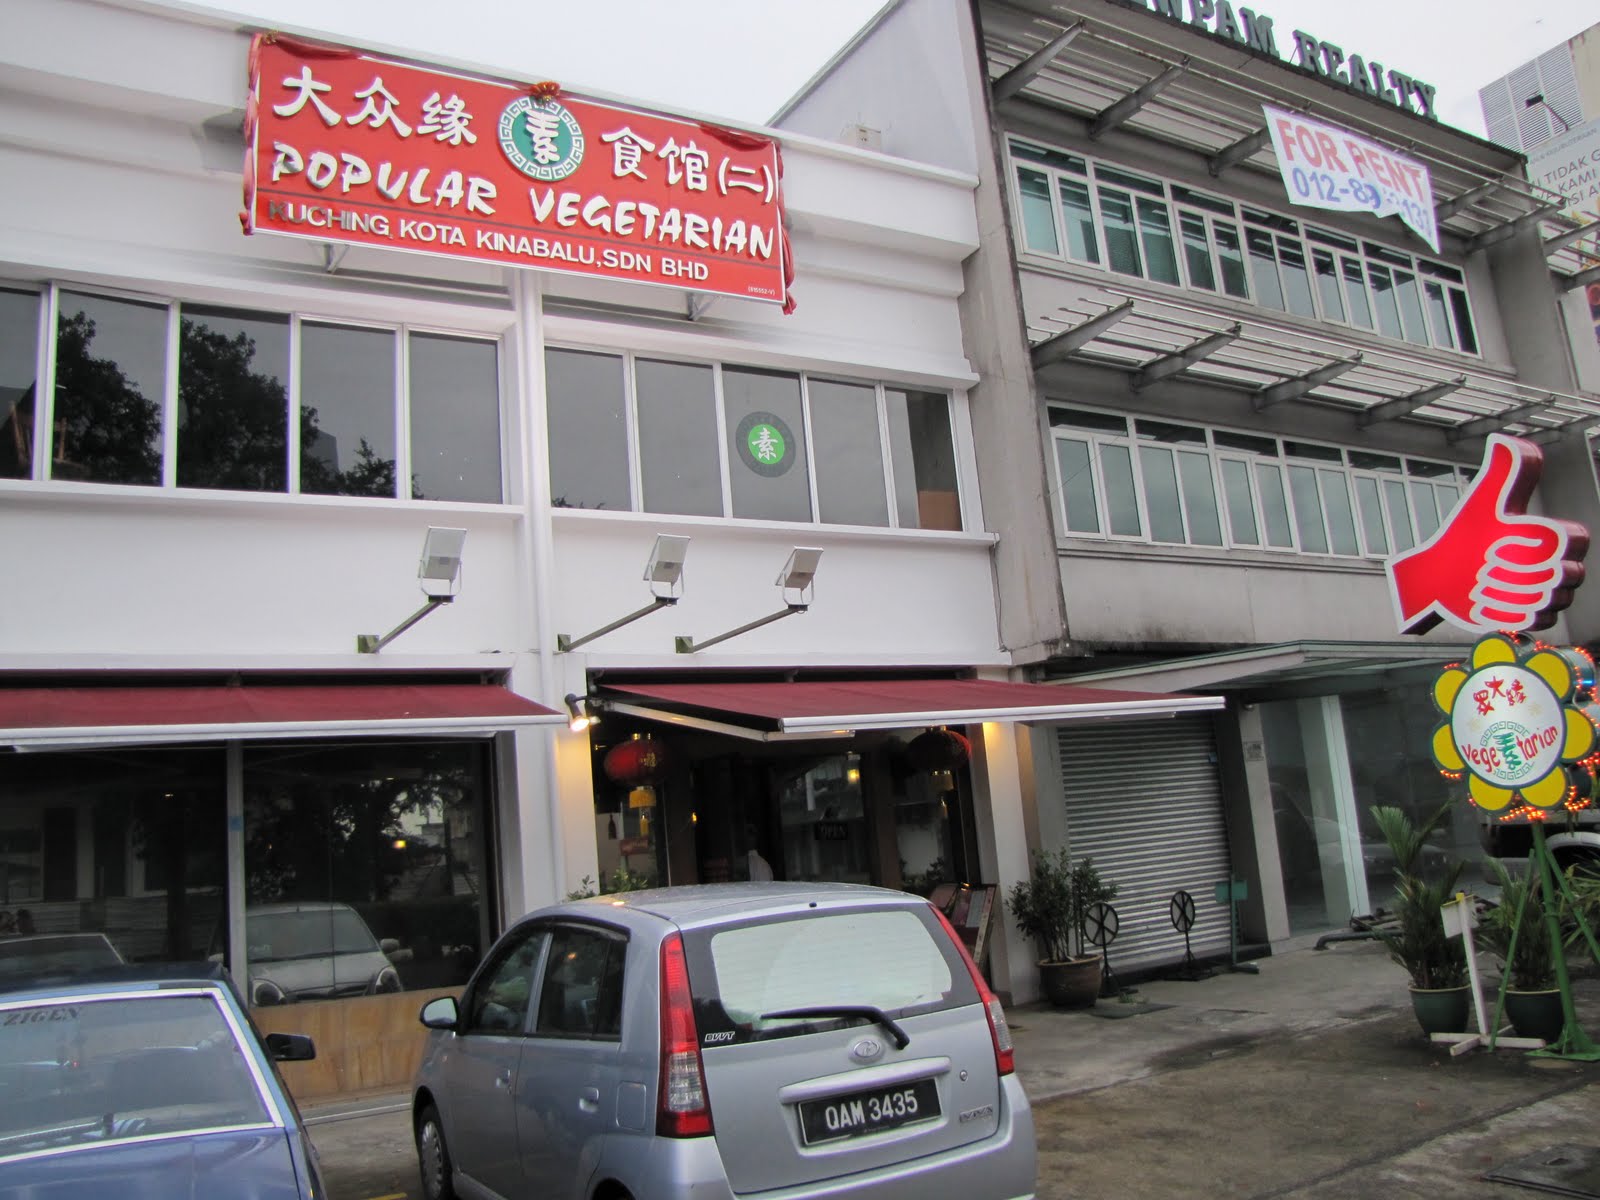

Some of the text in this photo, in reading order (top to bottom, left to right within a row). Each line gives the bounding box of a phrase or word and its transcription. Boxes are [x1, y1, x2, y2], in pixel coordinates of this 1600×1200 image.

[1292, 30, 1438, 122] REALTY
[273, 66, 478, 146] 大众缘
[1275, 119, 1426, 202] FOR RENT
[1544, 156, 1588, 184] TIDAK
[1558, 168, 1597, 194] KAMI
[272, 141, 774, 259] POPULAR VEGETARIAN
[400, 219, 467, 247] KOTA
[661, 257, 709, 281] BHD
[751, 426, 779, 461] 素
[1461, 743, 1501, 773] Vege
[1516, 725, 1558, 761] tarian
[825, 1104, 866, 1131] QAM
[868, 1089, 919, 1122] 3435
